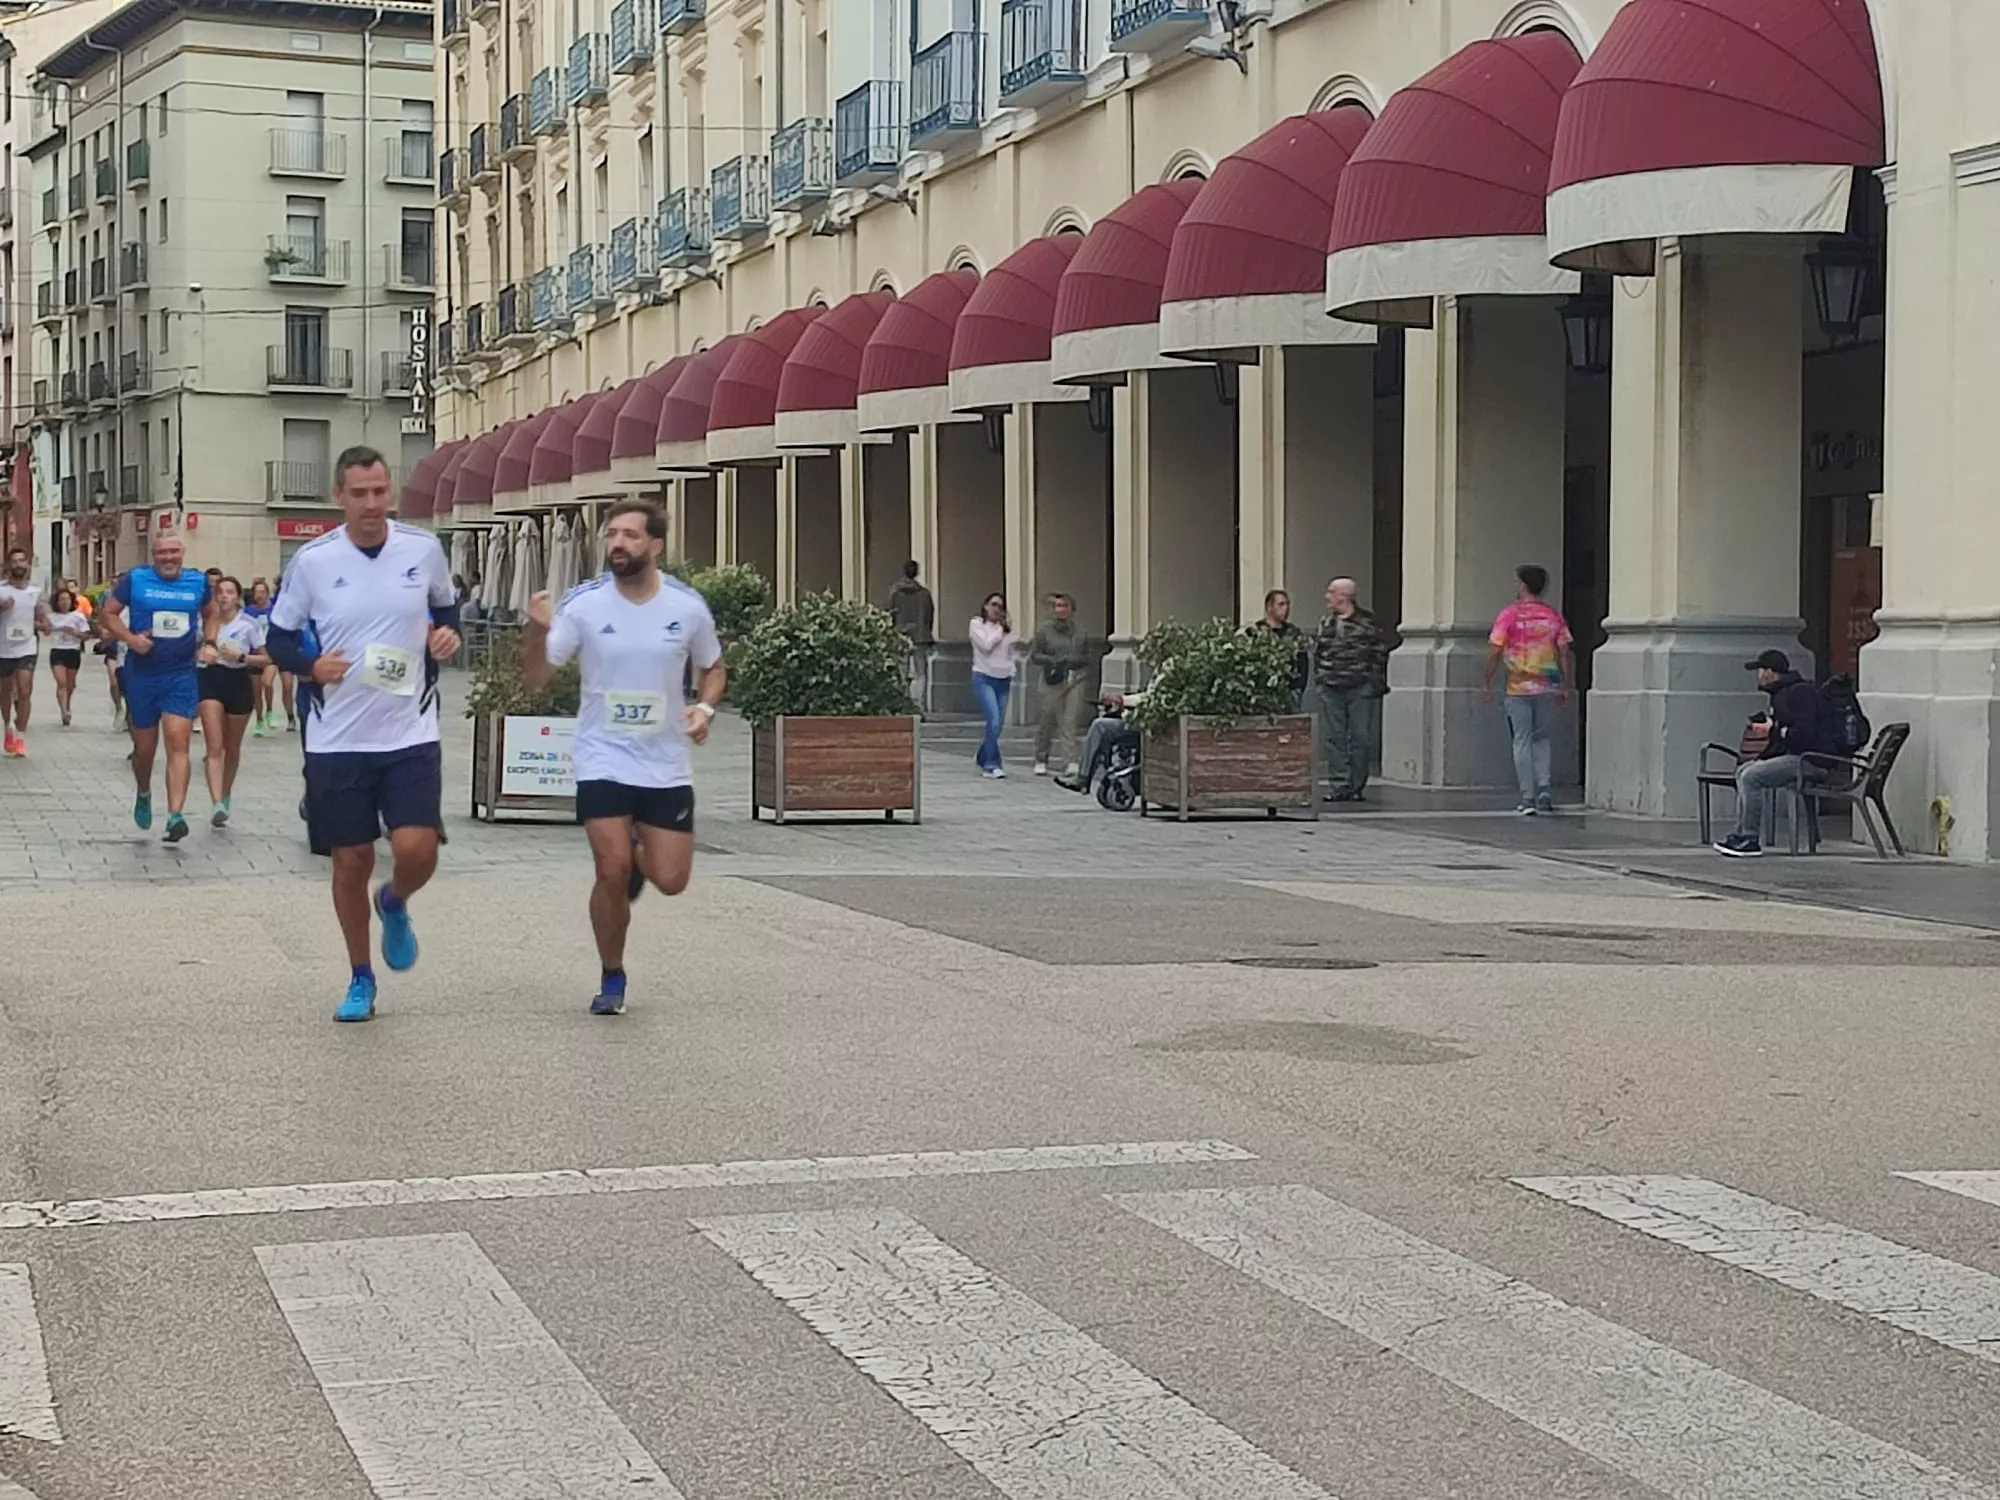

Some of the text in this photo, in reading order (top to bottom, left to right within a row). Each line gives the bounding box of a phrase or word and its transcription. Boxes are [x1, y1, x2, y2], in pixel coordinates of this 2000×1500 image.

[411, 308, 427, 413] HOSTAL
[376, 656, 407, 678] 338
[614, 703, 652, 719] 337
